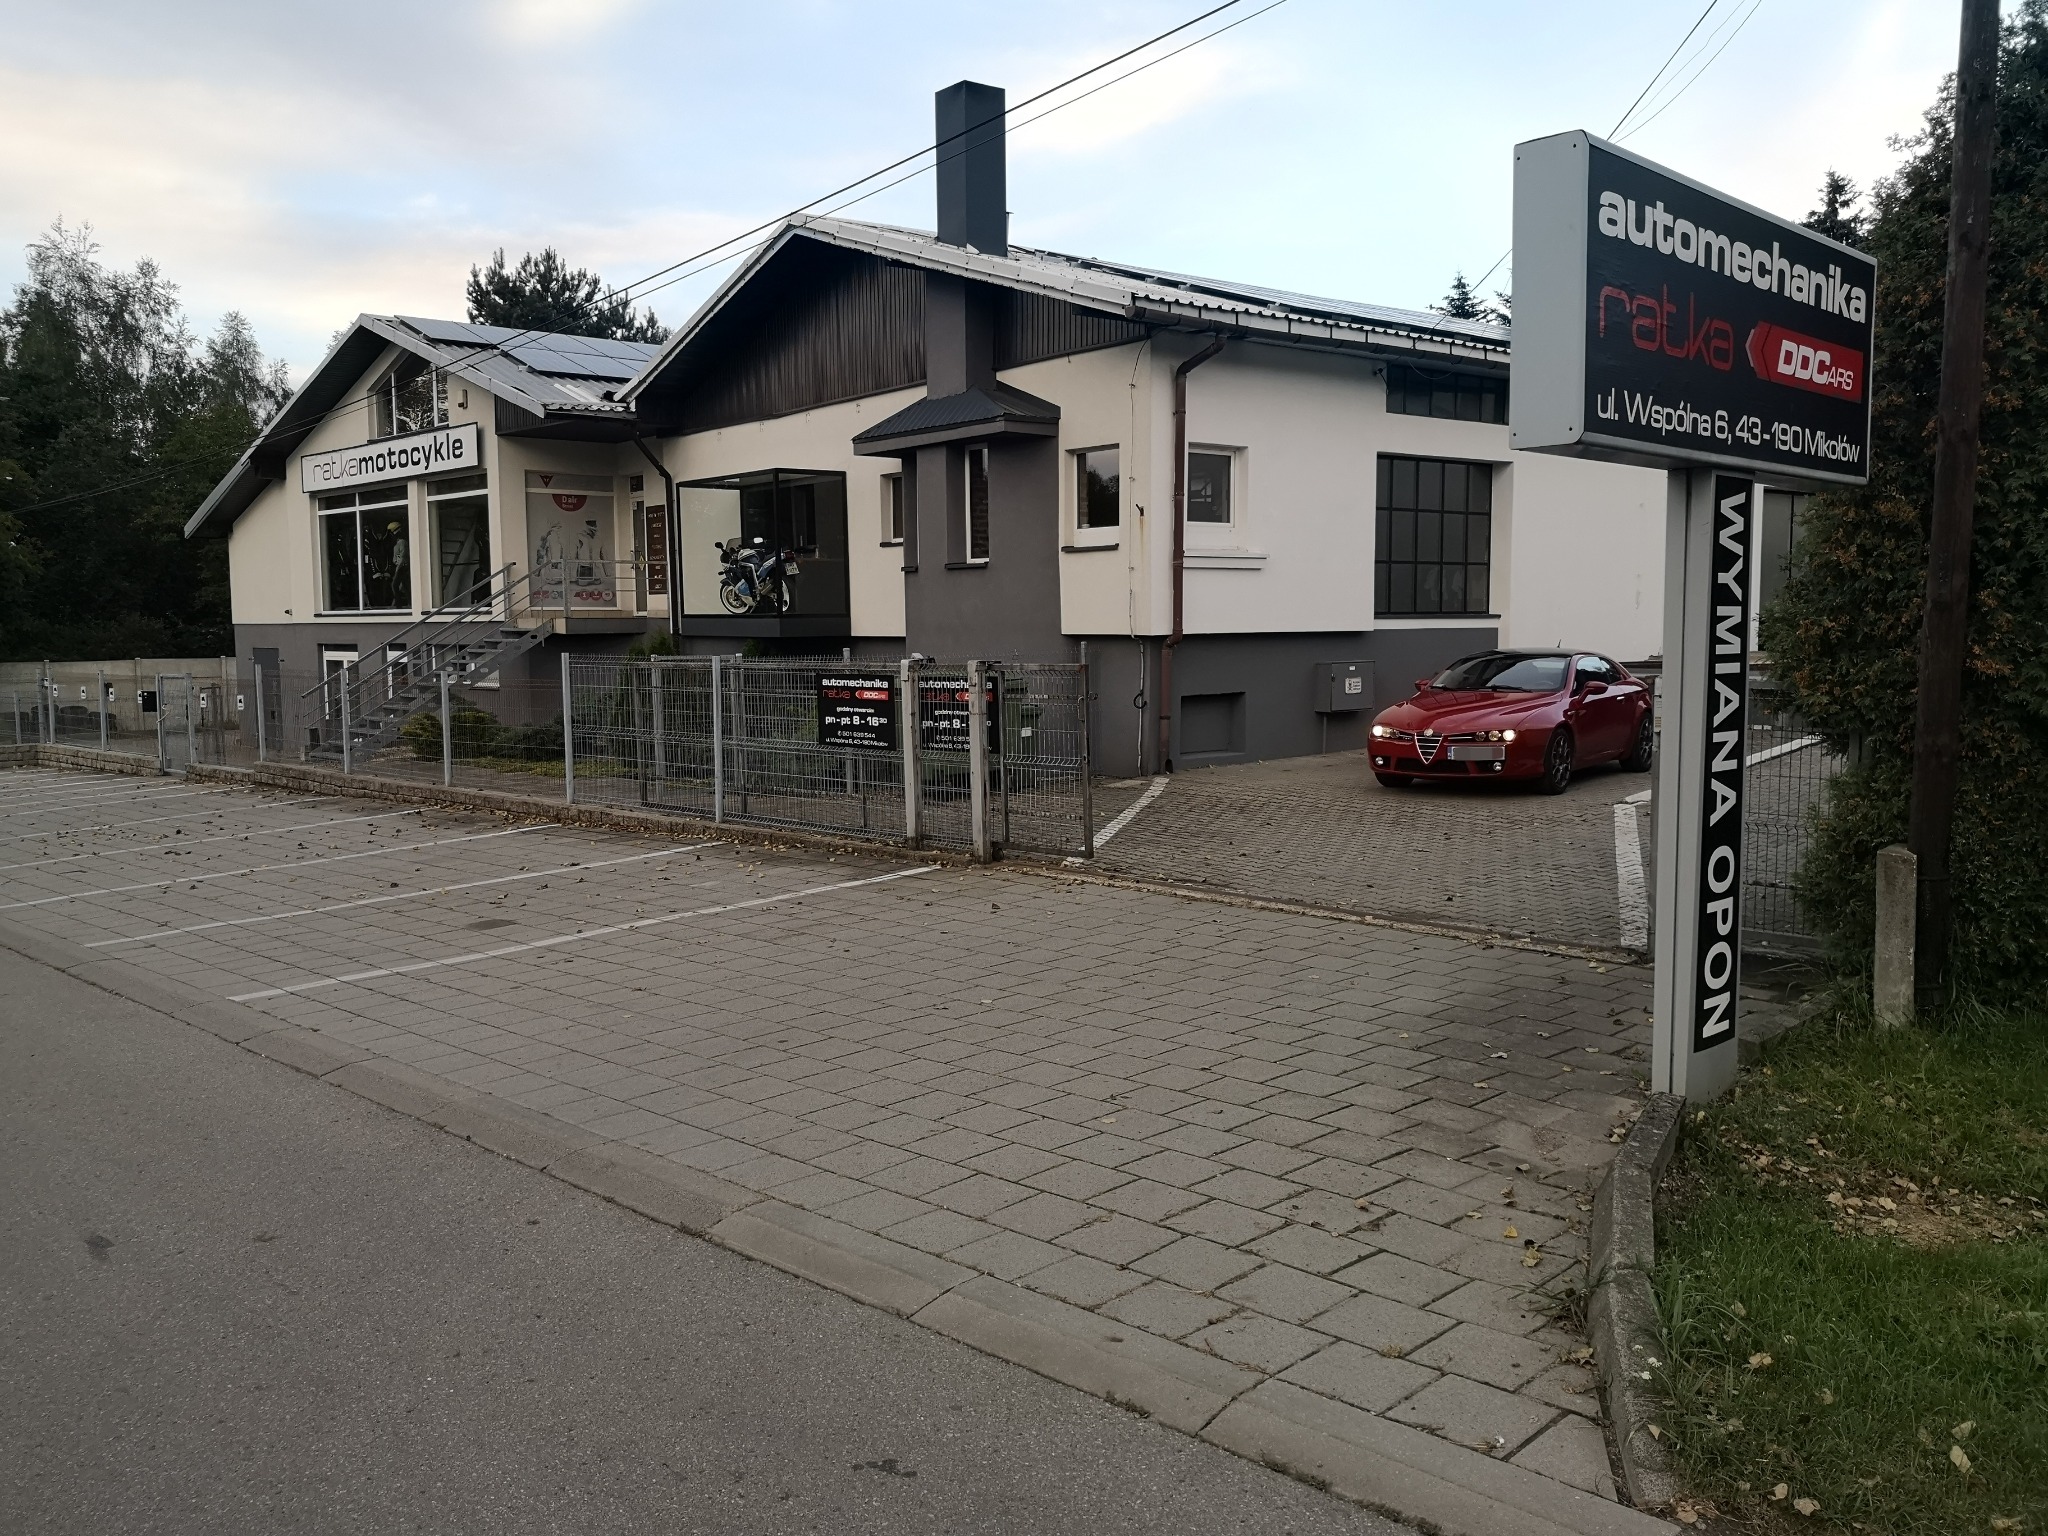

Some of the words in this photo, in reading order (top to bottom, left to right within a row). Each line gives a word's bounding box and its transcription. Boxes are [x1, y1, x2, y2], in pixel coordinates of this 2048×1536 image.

[1598, 190, 1867, 324] automechanika
[1599, 282, 1735, 372] ratka
[1597, 387, 1619, 421] ul.
[1623, 390, 1711, 437] Wspólna
[1714, 409, 1732, 445] 6,
[1804, 430, 1860, 463] Mikołów
[822, 678, 889, 688] automechanika
[918, 679, 993, 689] automecha
[1709, 491, 1746, 827] WYMIANA
[825, 716, 836, 725] pn
[841, 716, 851, 726] pt
[852, 715, 860, 725] 8
[952, 718, 960, 729] 8
[1702, 844, 1736, 1039] OPON
